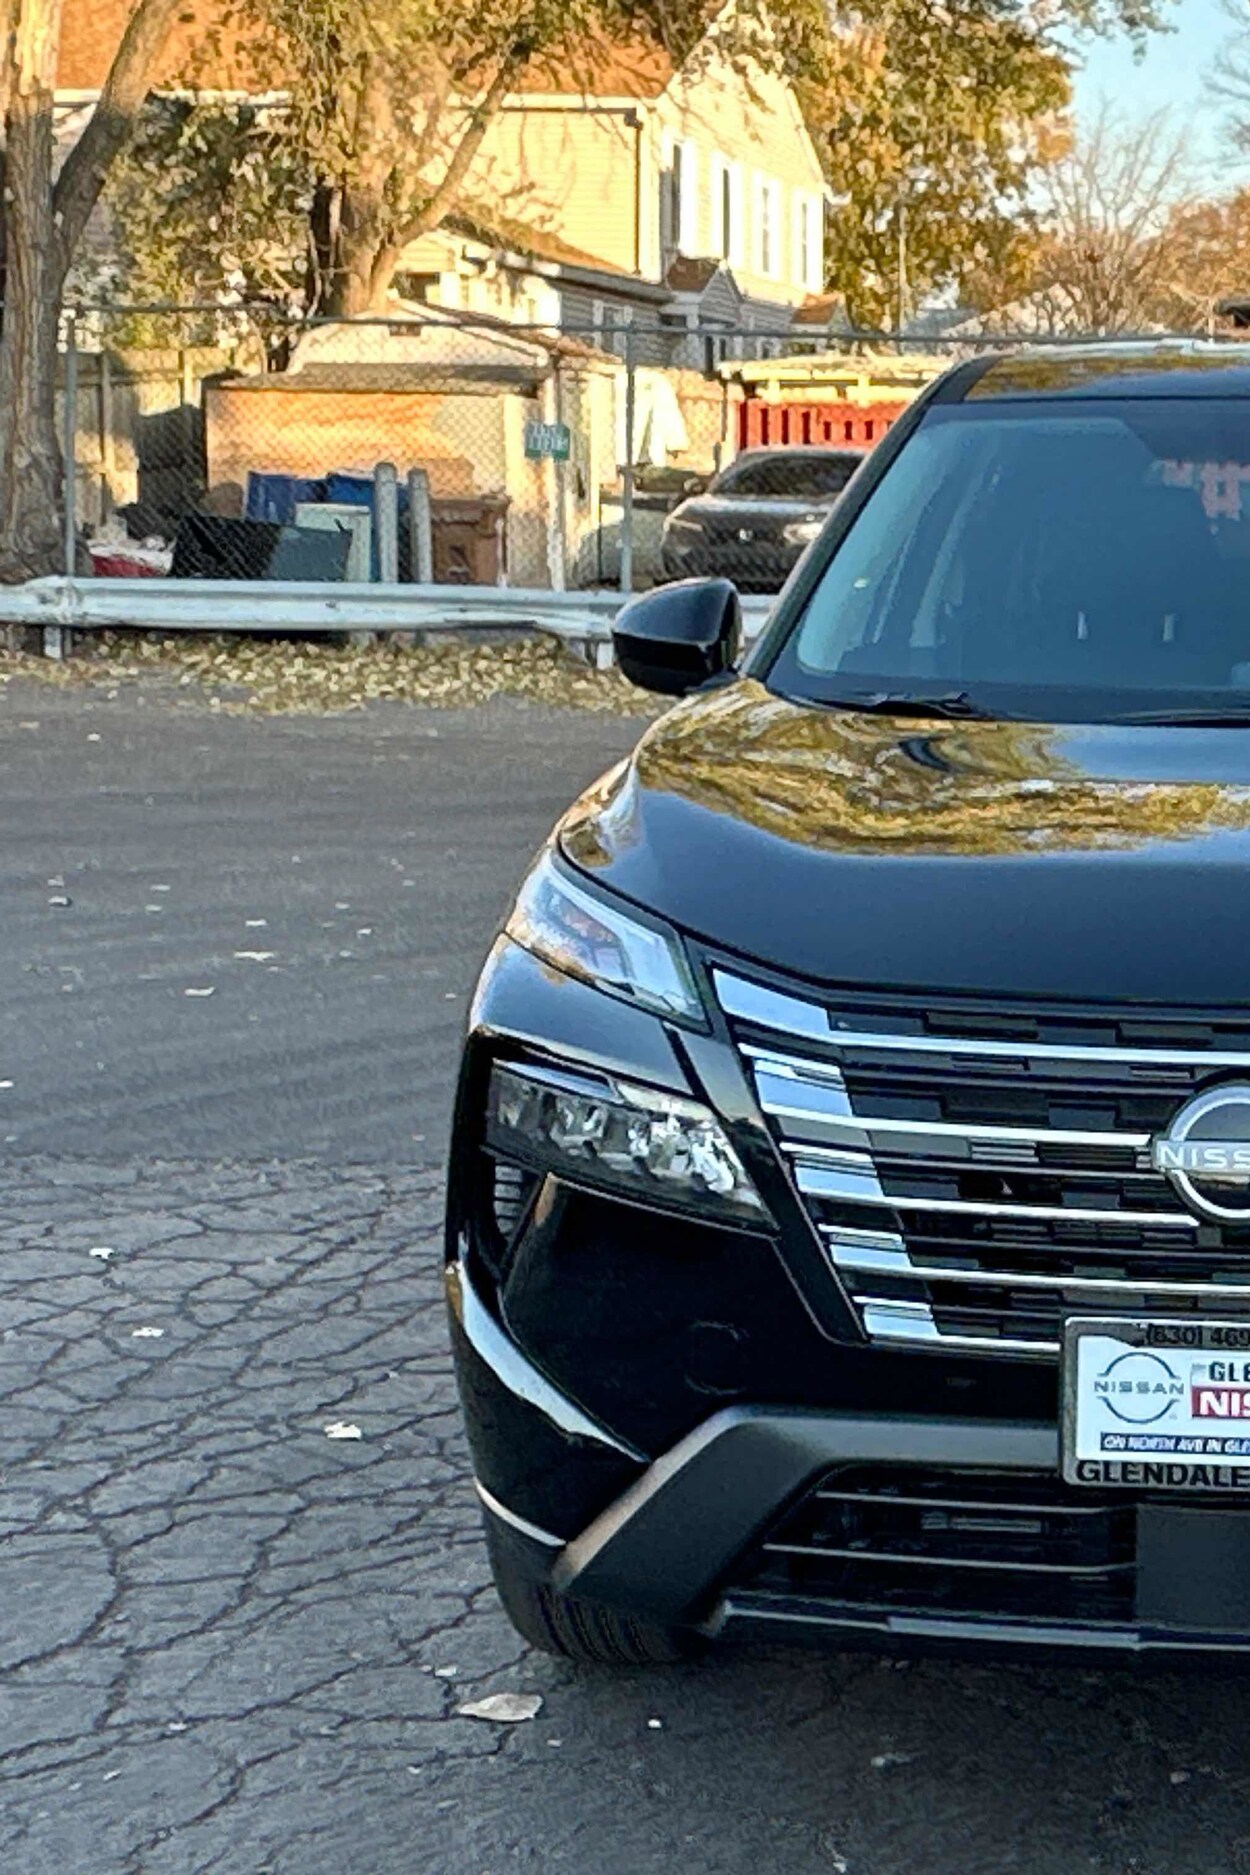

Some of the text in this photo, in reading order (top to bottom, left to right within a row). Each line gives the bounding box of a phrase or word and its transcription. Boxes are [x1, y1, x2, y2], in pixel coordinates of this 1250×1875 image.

[1094, 1380, 1185, 1396] NISSAN
[1104, 1434, 1126, 1449] ON
[1206, 1439, 1222, 1453] IN
[1076, 1460, 1250, 1488] GLENDALE
